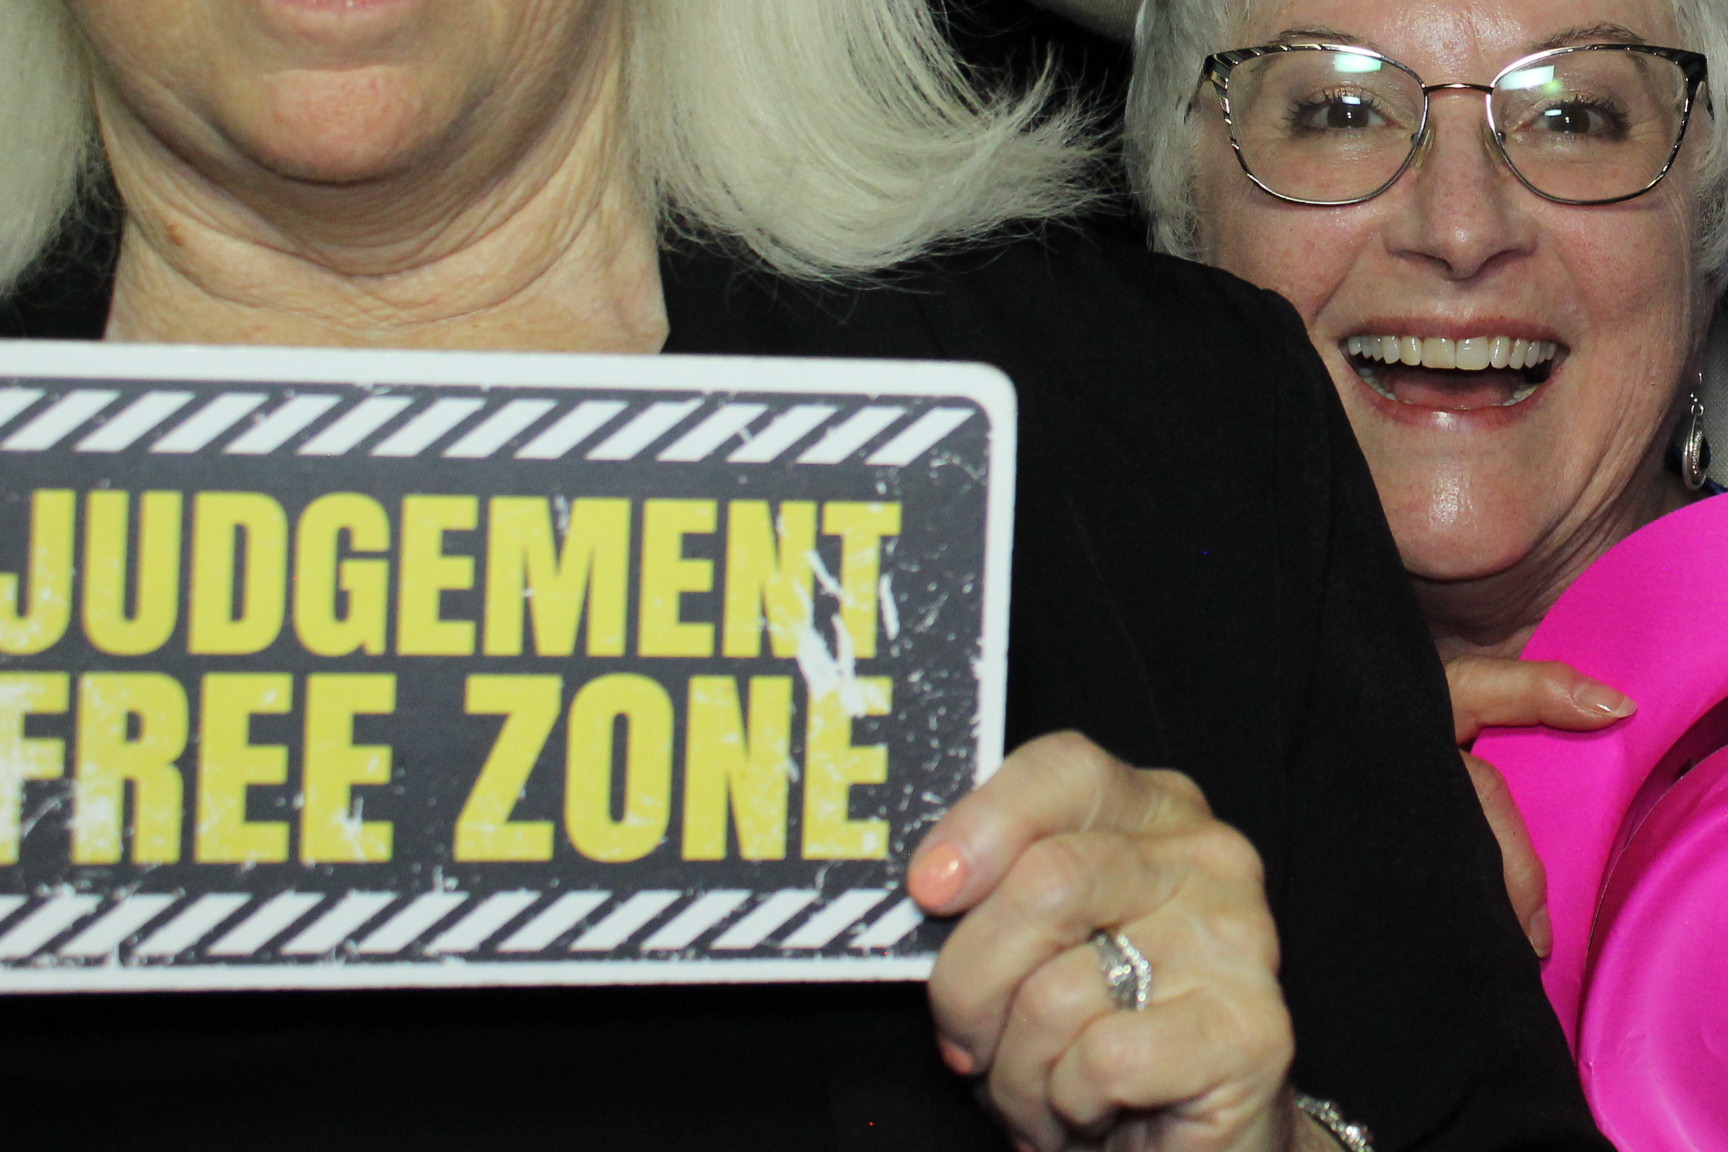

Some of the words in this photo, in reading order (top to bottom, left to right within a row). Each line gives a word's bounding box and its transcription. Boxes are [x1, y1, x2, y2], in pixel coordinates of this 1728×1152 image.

[0, 489, 902, 657] JUDGEMENT
[0, 672, 395, 864] FREE
[453, 673, 892, 863] ZONE
